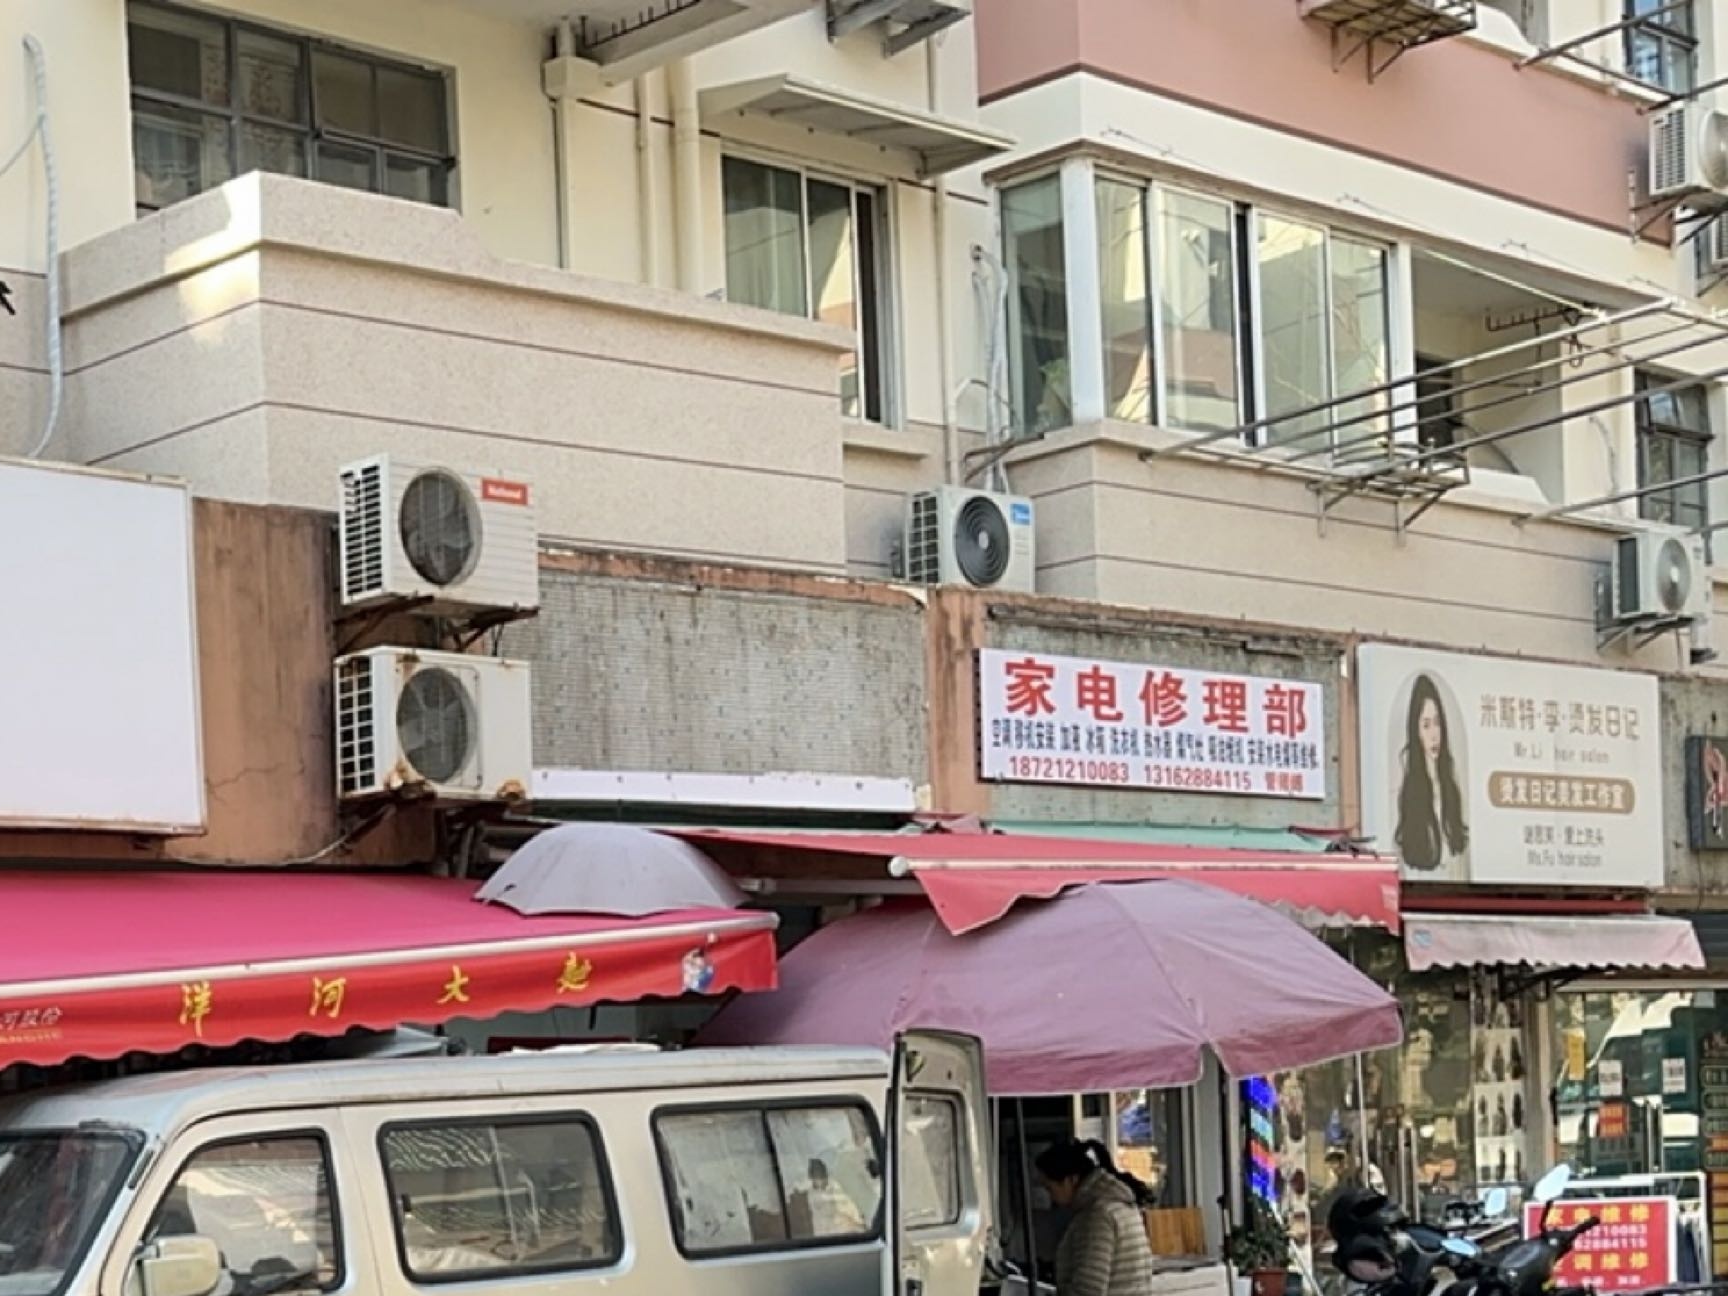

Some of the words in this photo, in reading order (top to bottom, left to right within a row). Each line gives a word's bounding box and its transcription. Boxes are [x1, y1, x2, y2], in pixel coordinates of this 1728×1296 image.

[1004, 657, 1307, 738] 家电修理部
[1009, 755, 1129, 782] 18721210083
[1144, 764, 1252, 791] 13162884115
